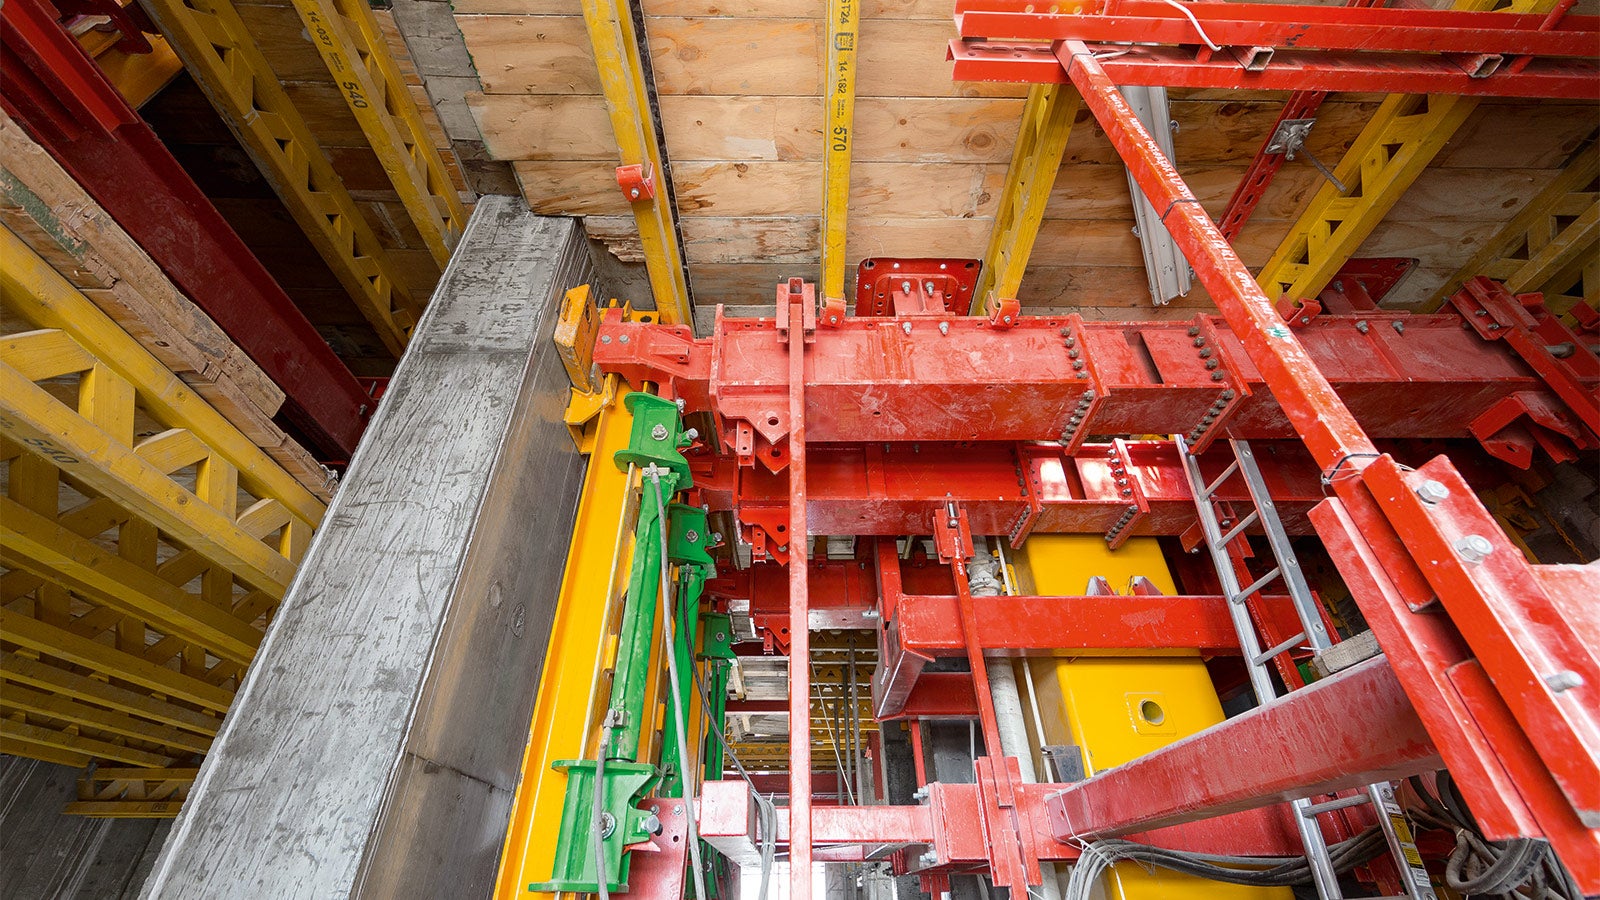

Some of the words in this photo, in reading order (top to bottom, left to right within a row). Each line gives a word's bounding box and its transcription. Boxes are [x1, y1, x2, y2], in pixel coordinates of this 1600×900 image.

[307, 11, 333, 47] 14-037
[838, 61, 848, 94] 14-182
[343, 81, 368, 109] 540
[833, 127, 847, 152] 570
[23, 438, 79, 463] 540
